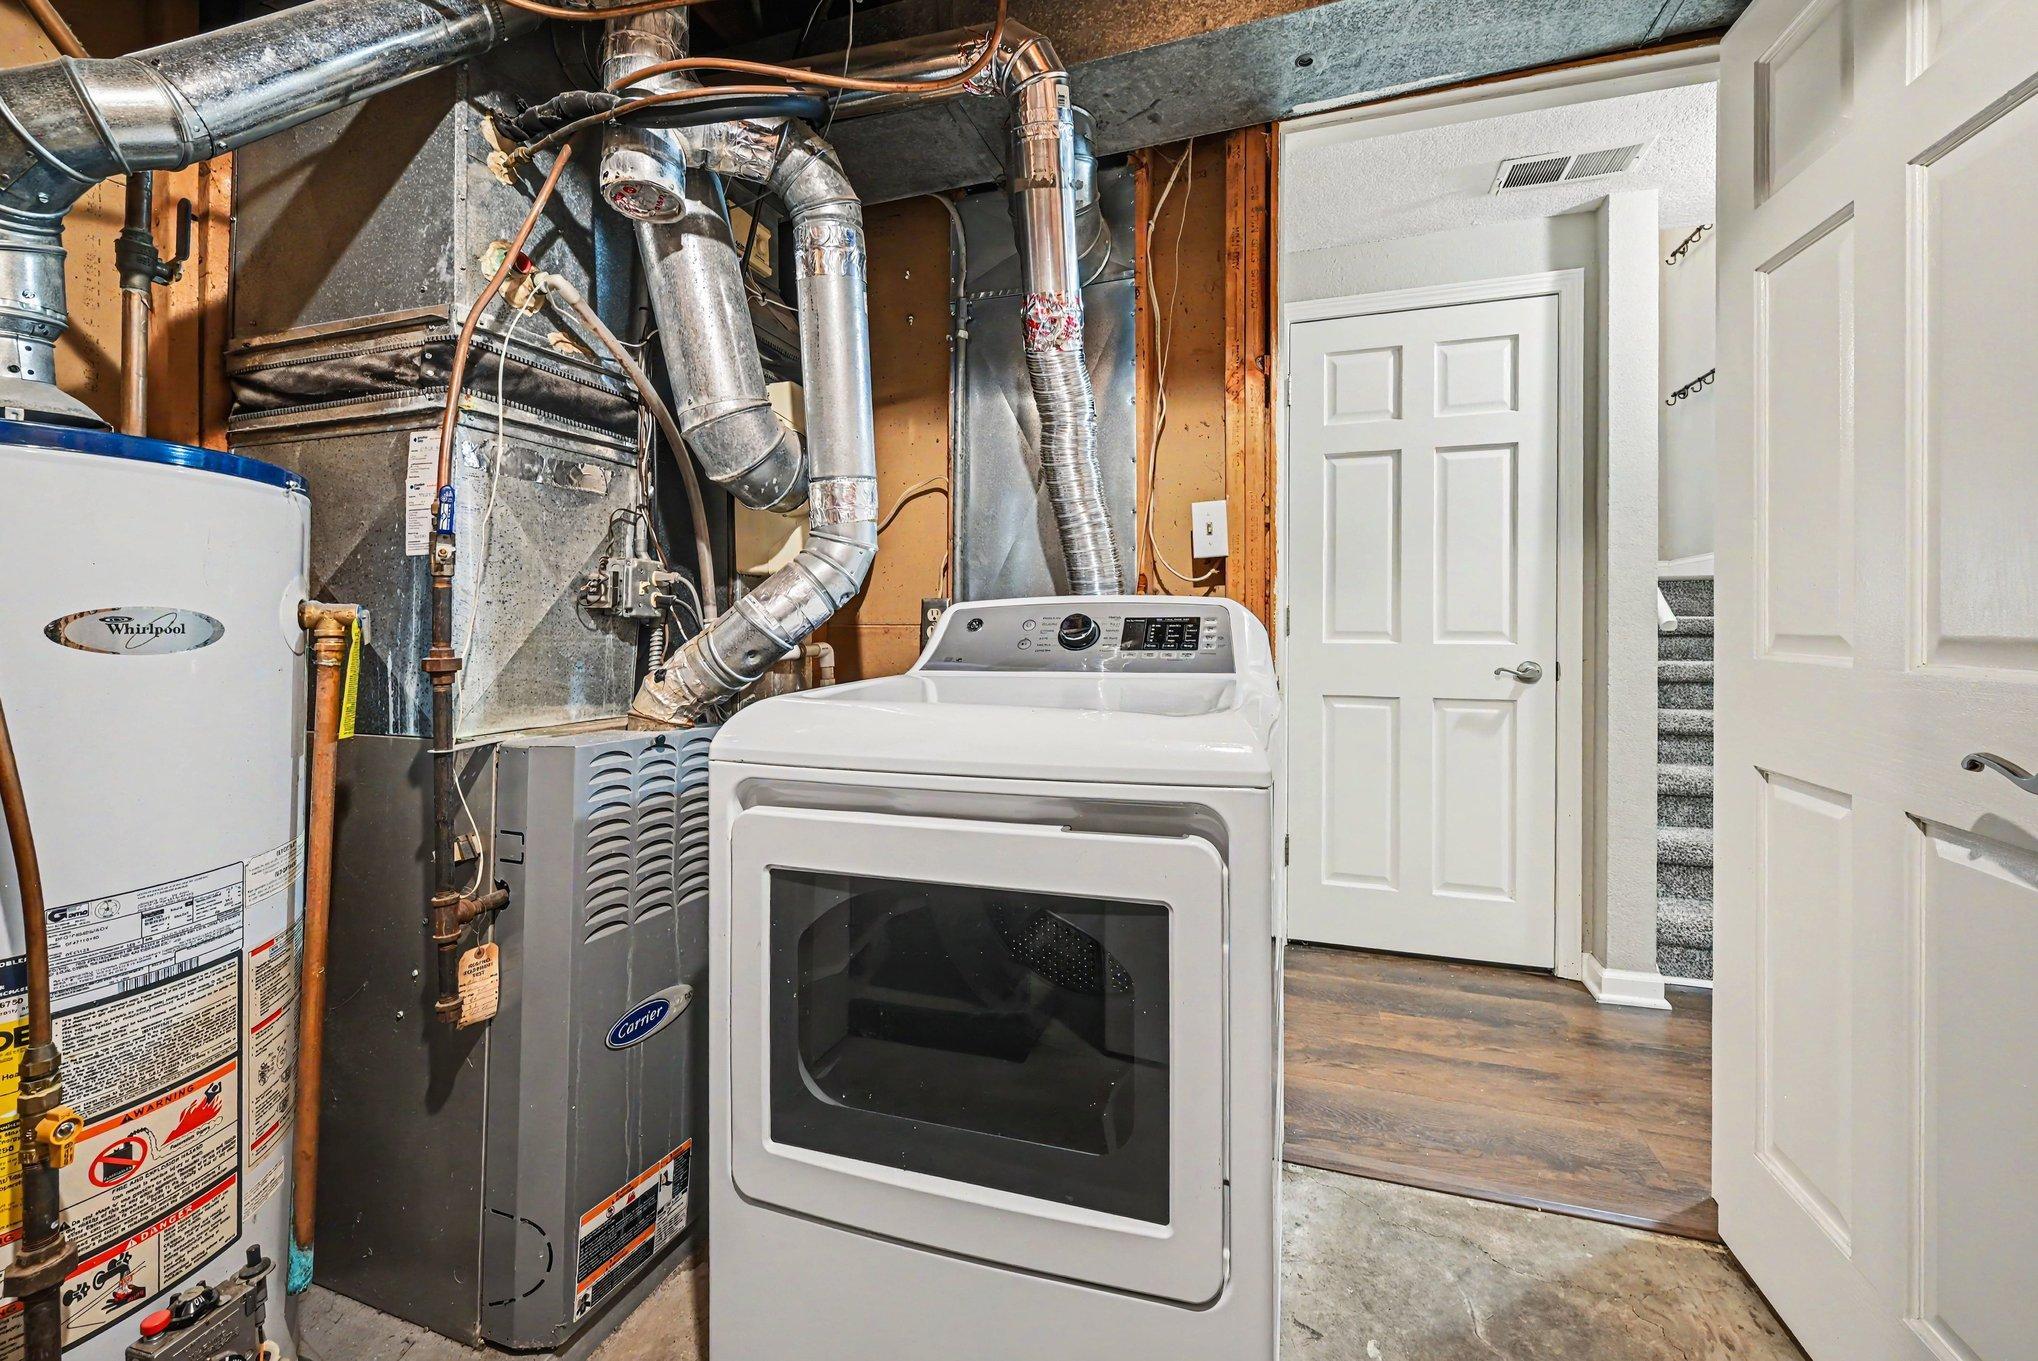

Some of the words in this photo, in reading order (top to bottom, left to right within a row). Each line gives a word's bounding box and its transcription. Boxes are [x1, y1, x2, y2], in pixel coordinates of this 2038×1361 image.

[106, 622, 186, 638] Whirlpool
[617, 1006, 663, 1039] Carrier
[132, 1085, 195, 1119] WARNING
[129, 1175, 143, 1186] AND
[144, 1157, 179, 1178] EXPLOSION
[180, 1143, 203, 1158] HAZARD
[140, 1205, 193, 1242] DANGER
[193, 1295, 206, 1307] ON
